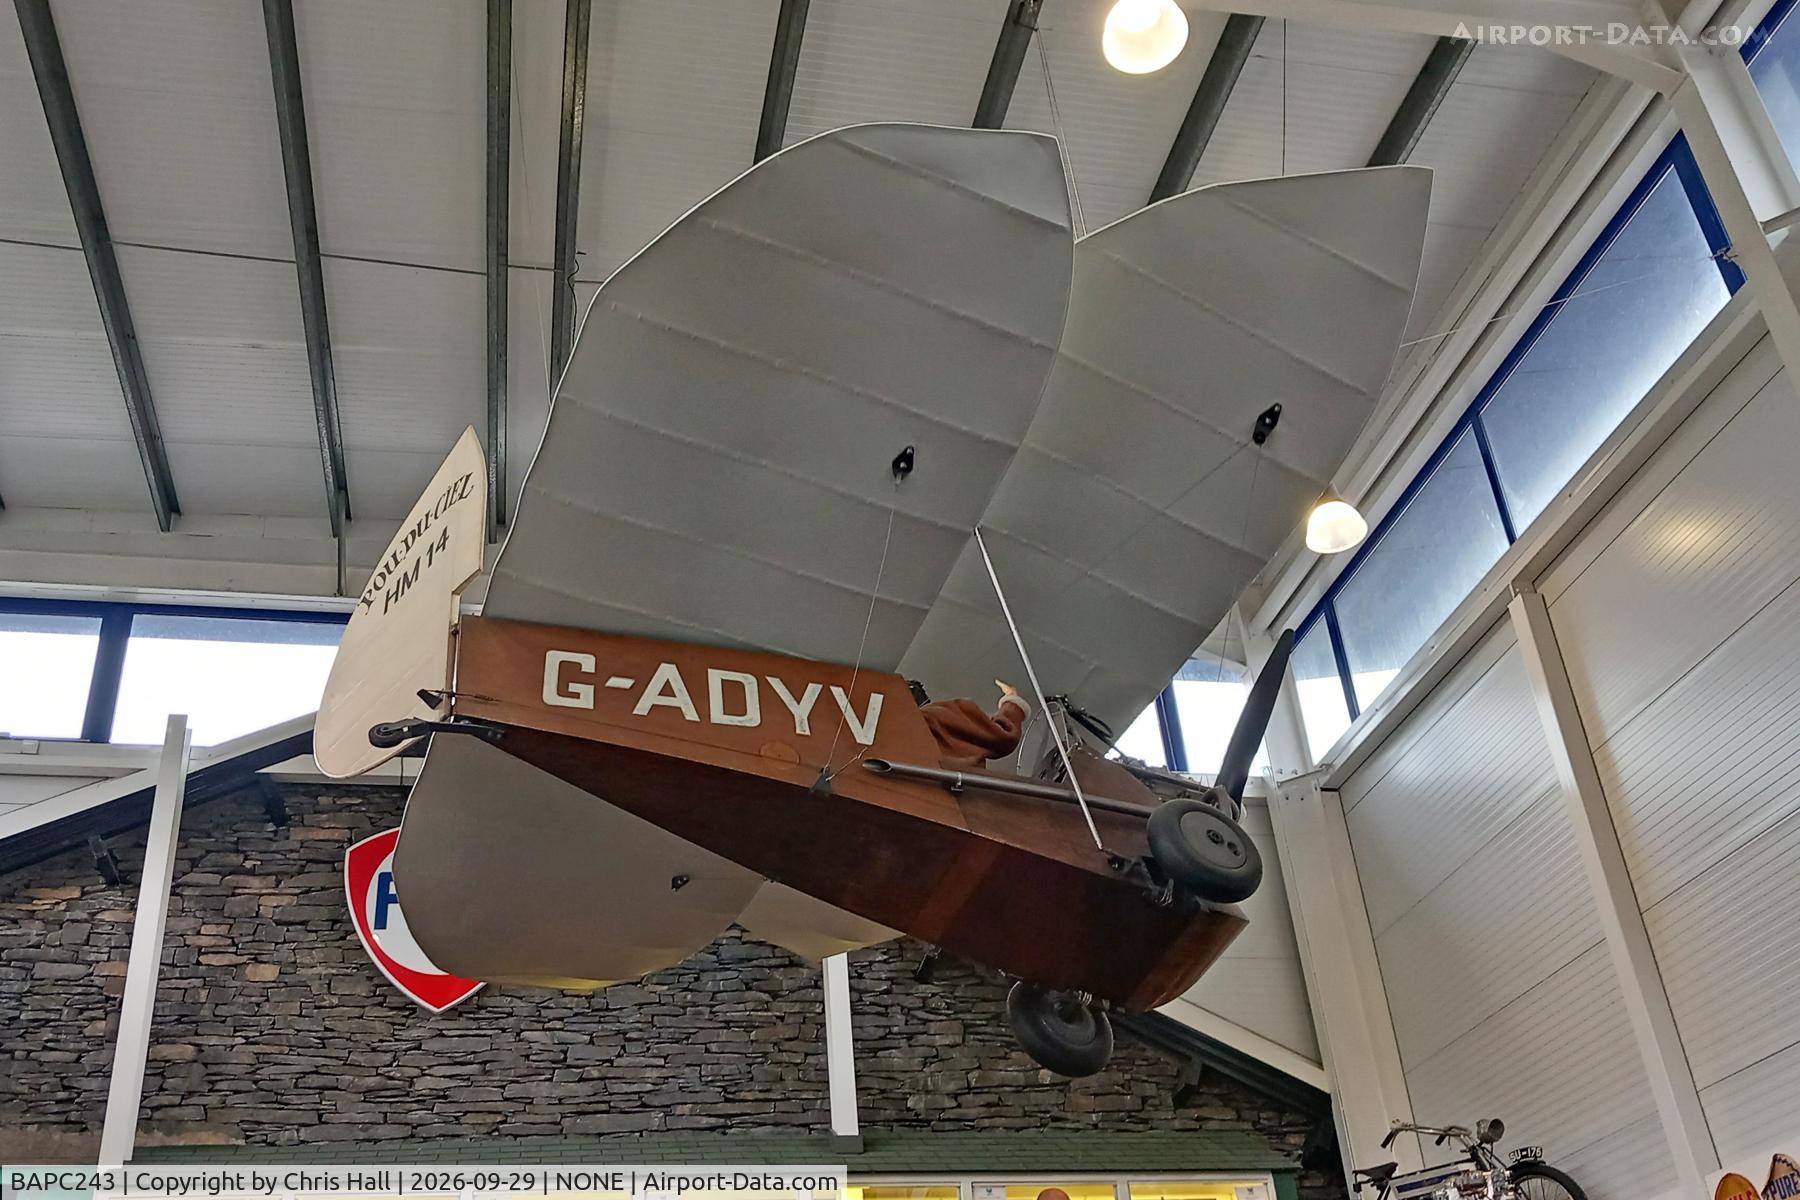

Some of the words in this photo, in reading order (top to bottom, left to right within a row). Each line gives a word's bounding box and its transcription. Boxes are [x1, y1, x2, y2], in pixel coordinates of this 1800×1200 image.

[383, 556, 421, 616] HM
[426, 525, 450, 569] 14
[541, 649, 885, 746] G-ADYV
[1509, 1146, 1542, 1162] SU-176
